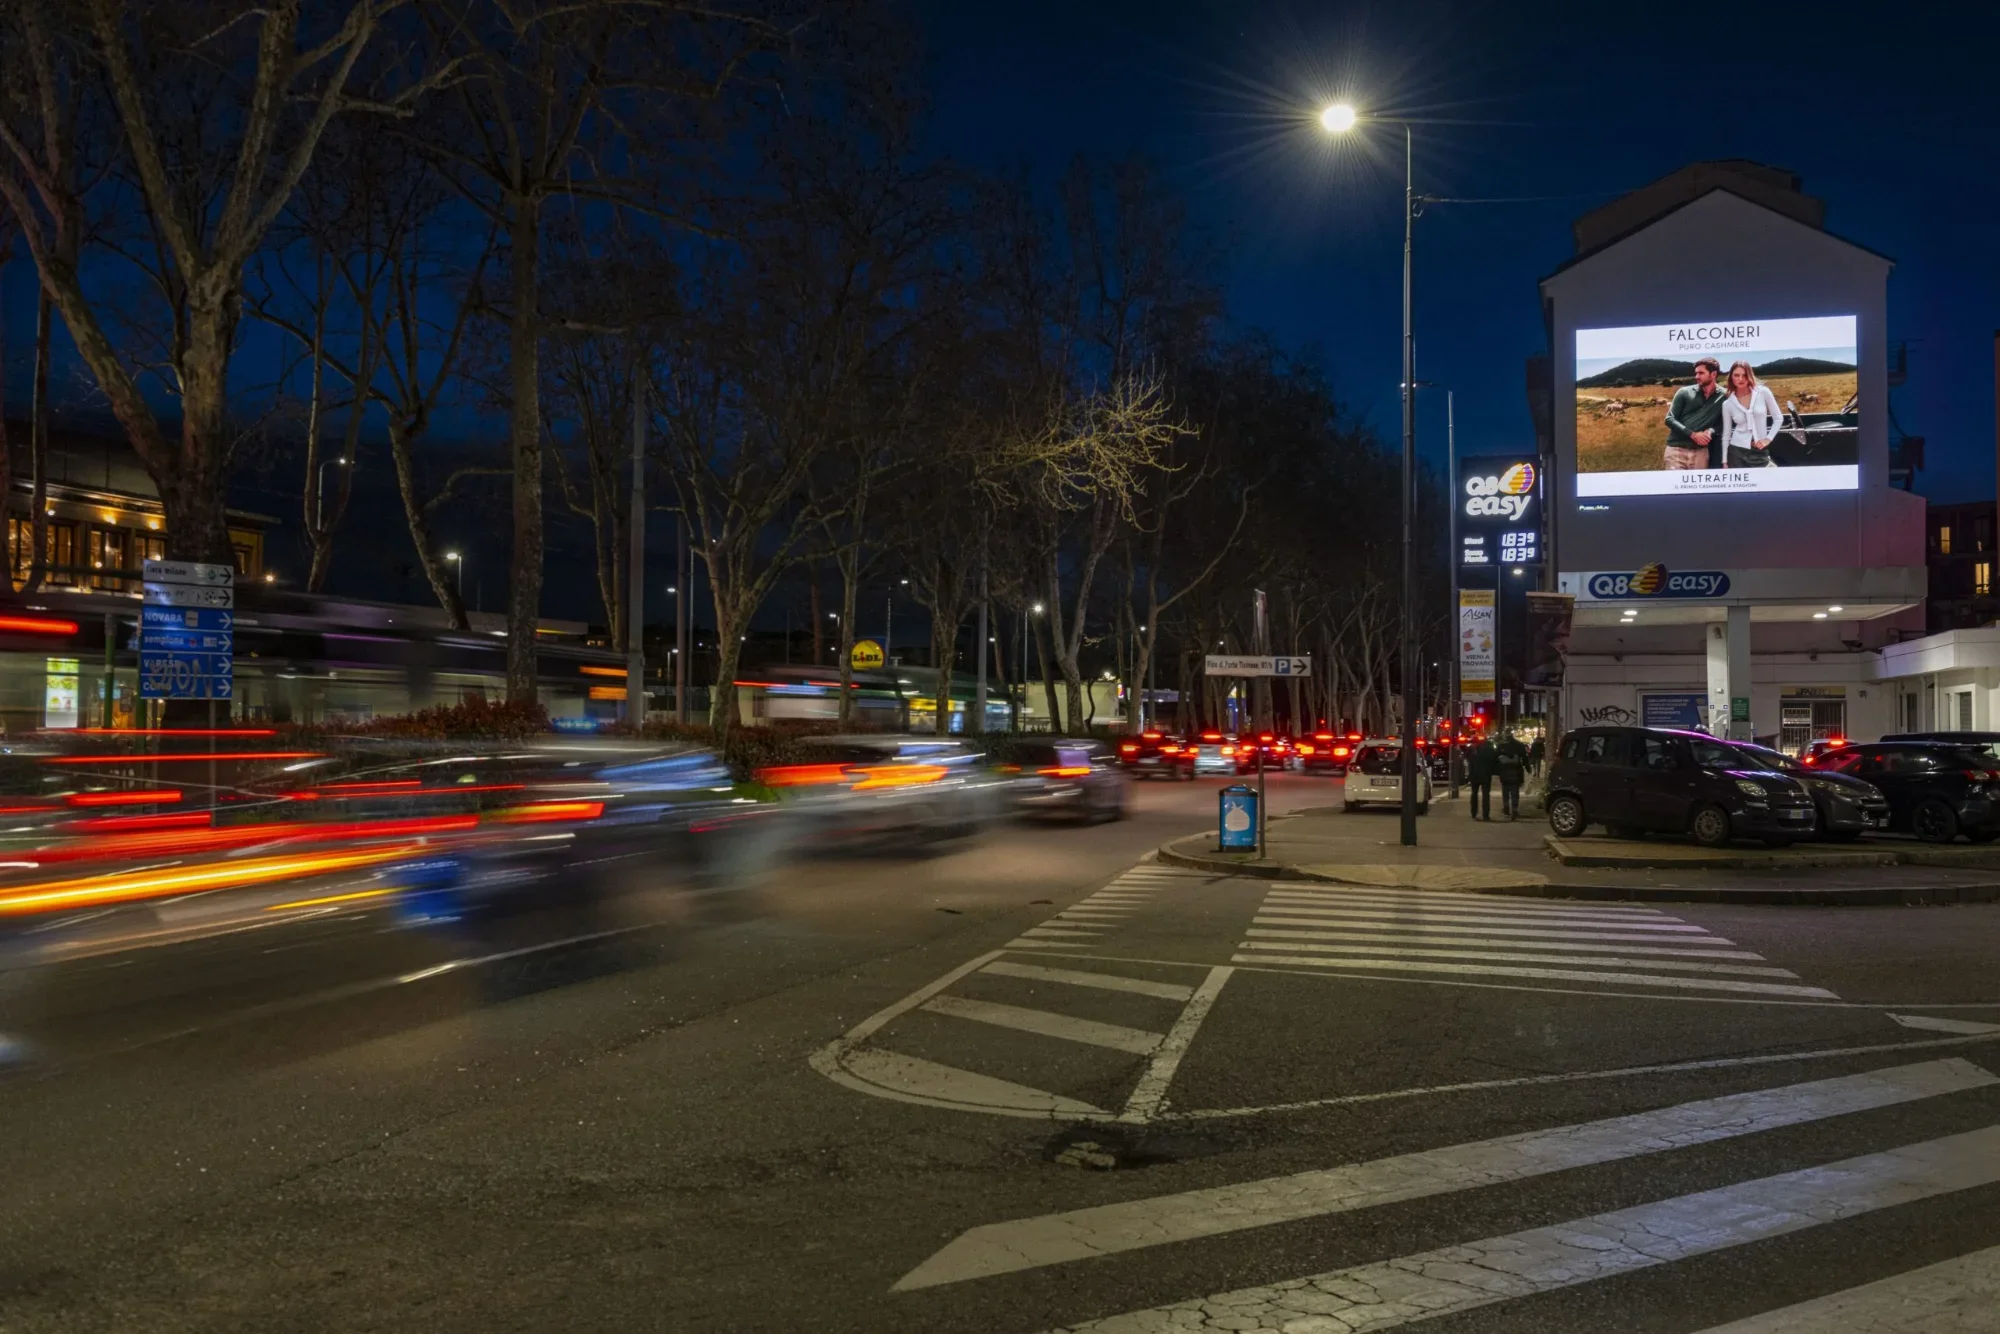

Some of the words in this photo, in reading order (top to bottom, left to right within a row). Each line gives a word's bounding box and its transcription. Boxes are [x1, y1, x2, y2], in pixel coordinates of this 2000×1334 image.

[1669, 325, 1760, 341] FALCONERI
[1705, 341, 1750, 349] CASHMERE
[1466, 476, 1498, 496] Q8
[1682, 473, 1749, 483] ULTRAFINE
[1466, 496, 1531, 521] easy
[1594, 576, 1629, 595] Q8
[1668, 575, 1723, 595] easy
[144, 612, 183, 623] NOVARA
